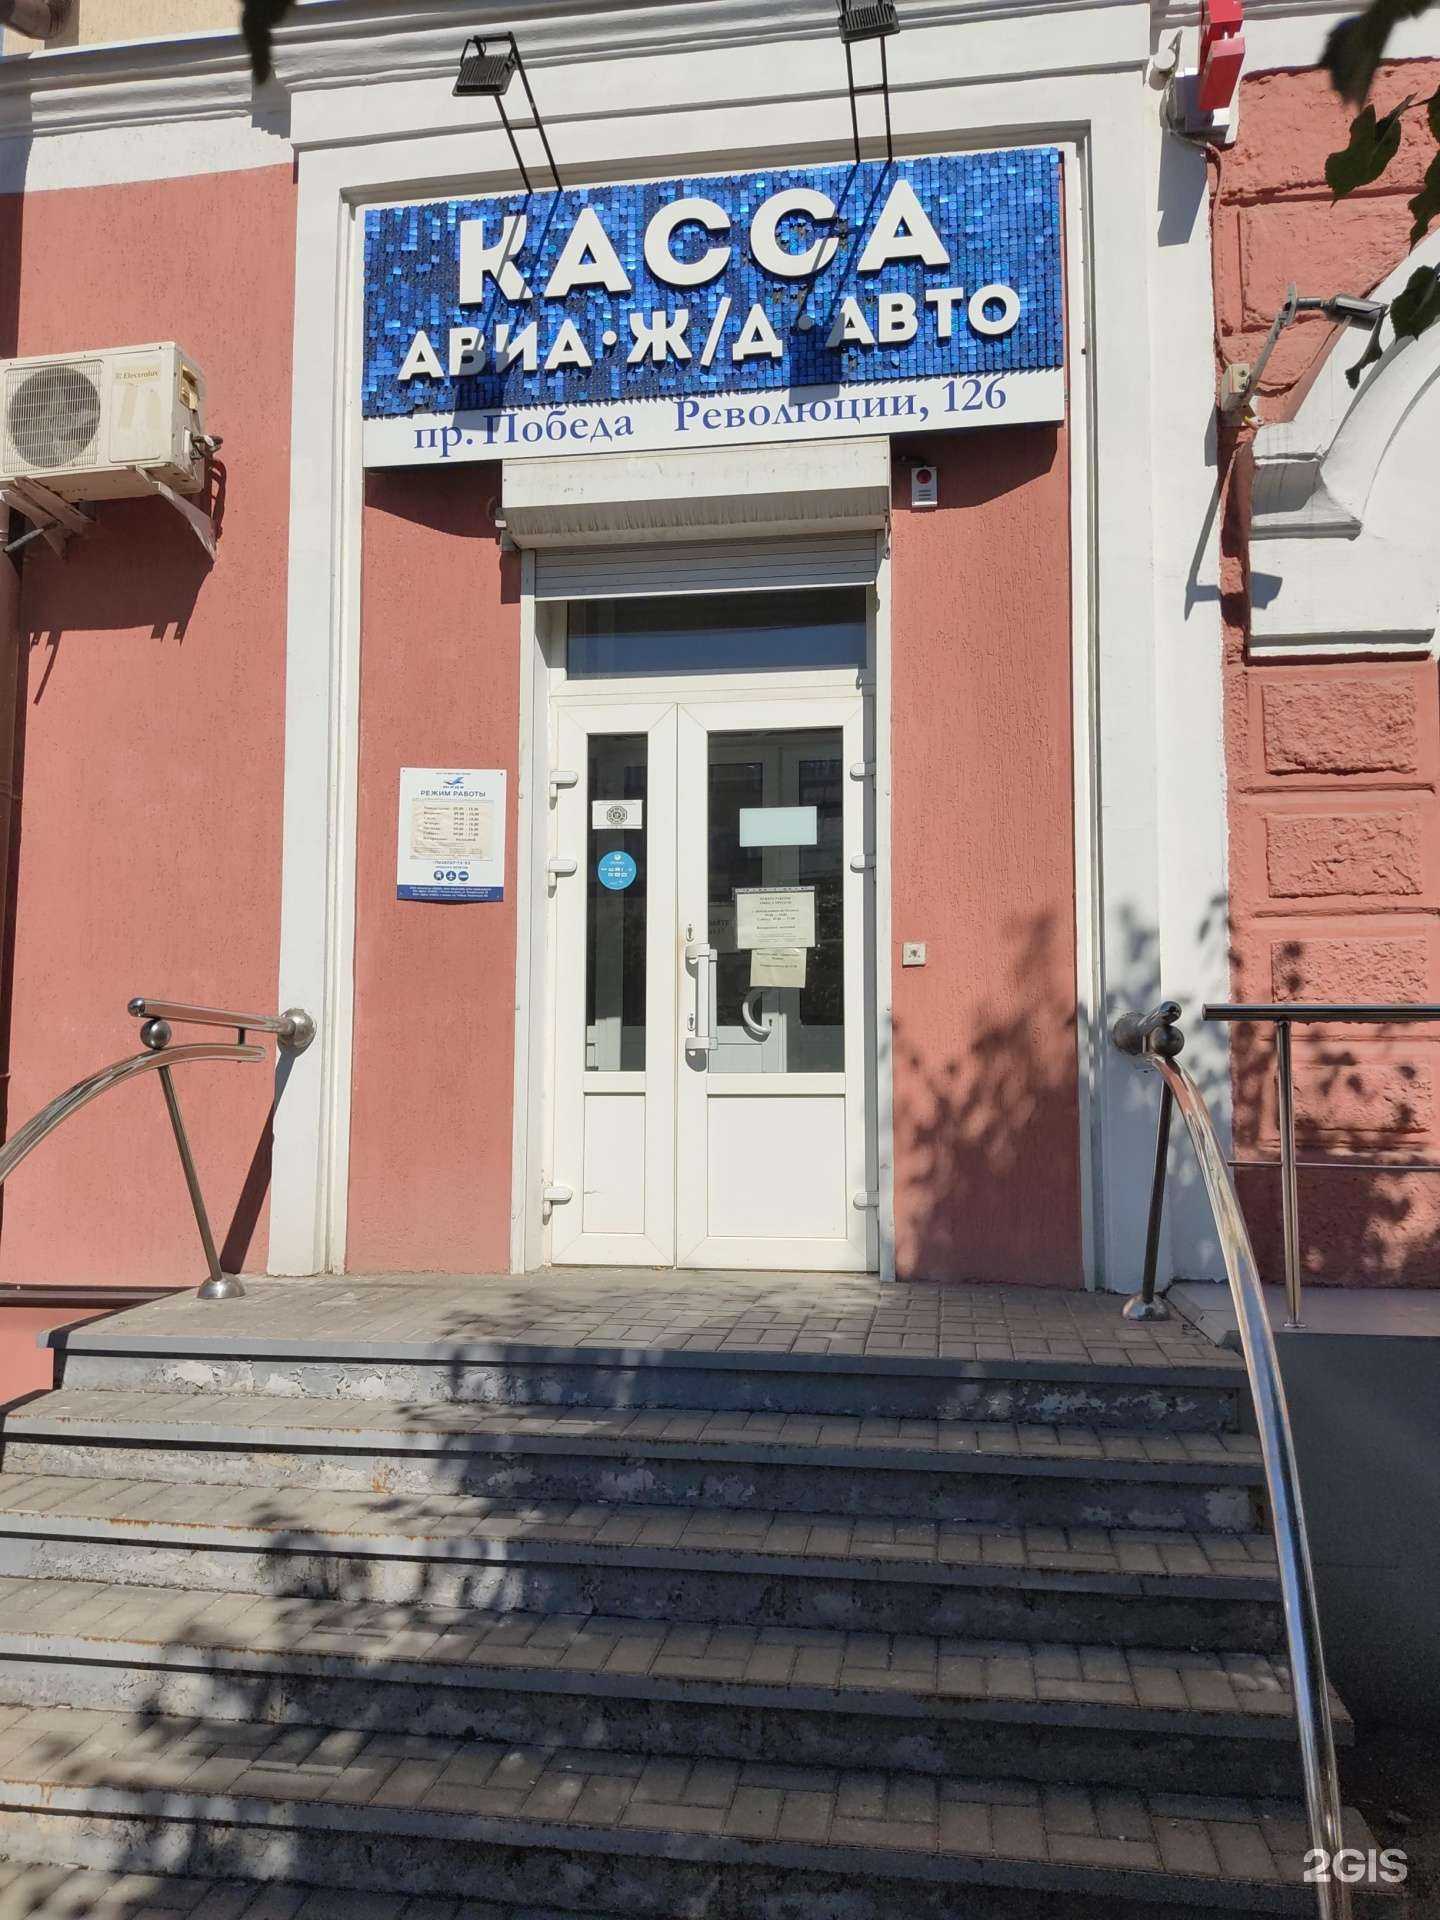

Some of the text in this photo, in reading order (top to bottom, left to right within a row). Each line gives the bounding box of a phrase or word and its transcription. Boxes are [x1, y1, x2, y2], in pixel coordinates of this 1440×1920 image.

[459, 179, 950, 305] КАССА
[414, 377, 1007, 458] пр. Победа Революции, 126
[420, 789, 451, 797] РЕЖИМ
